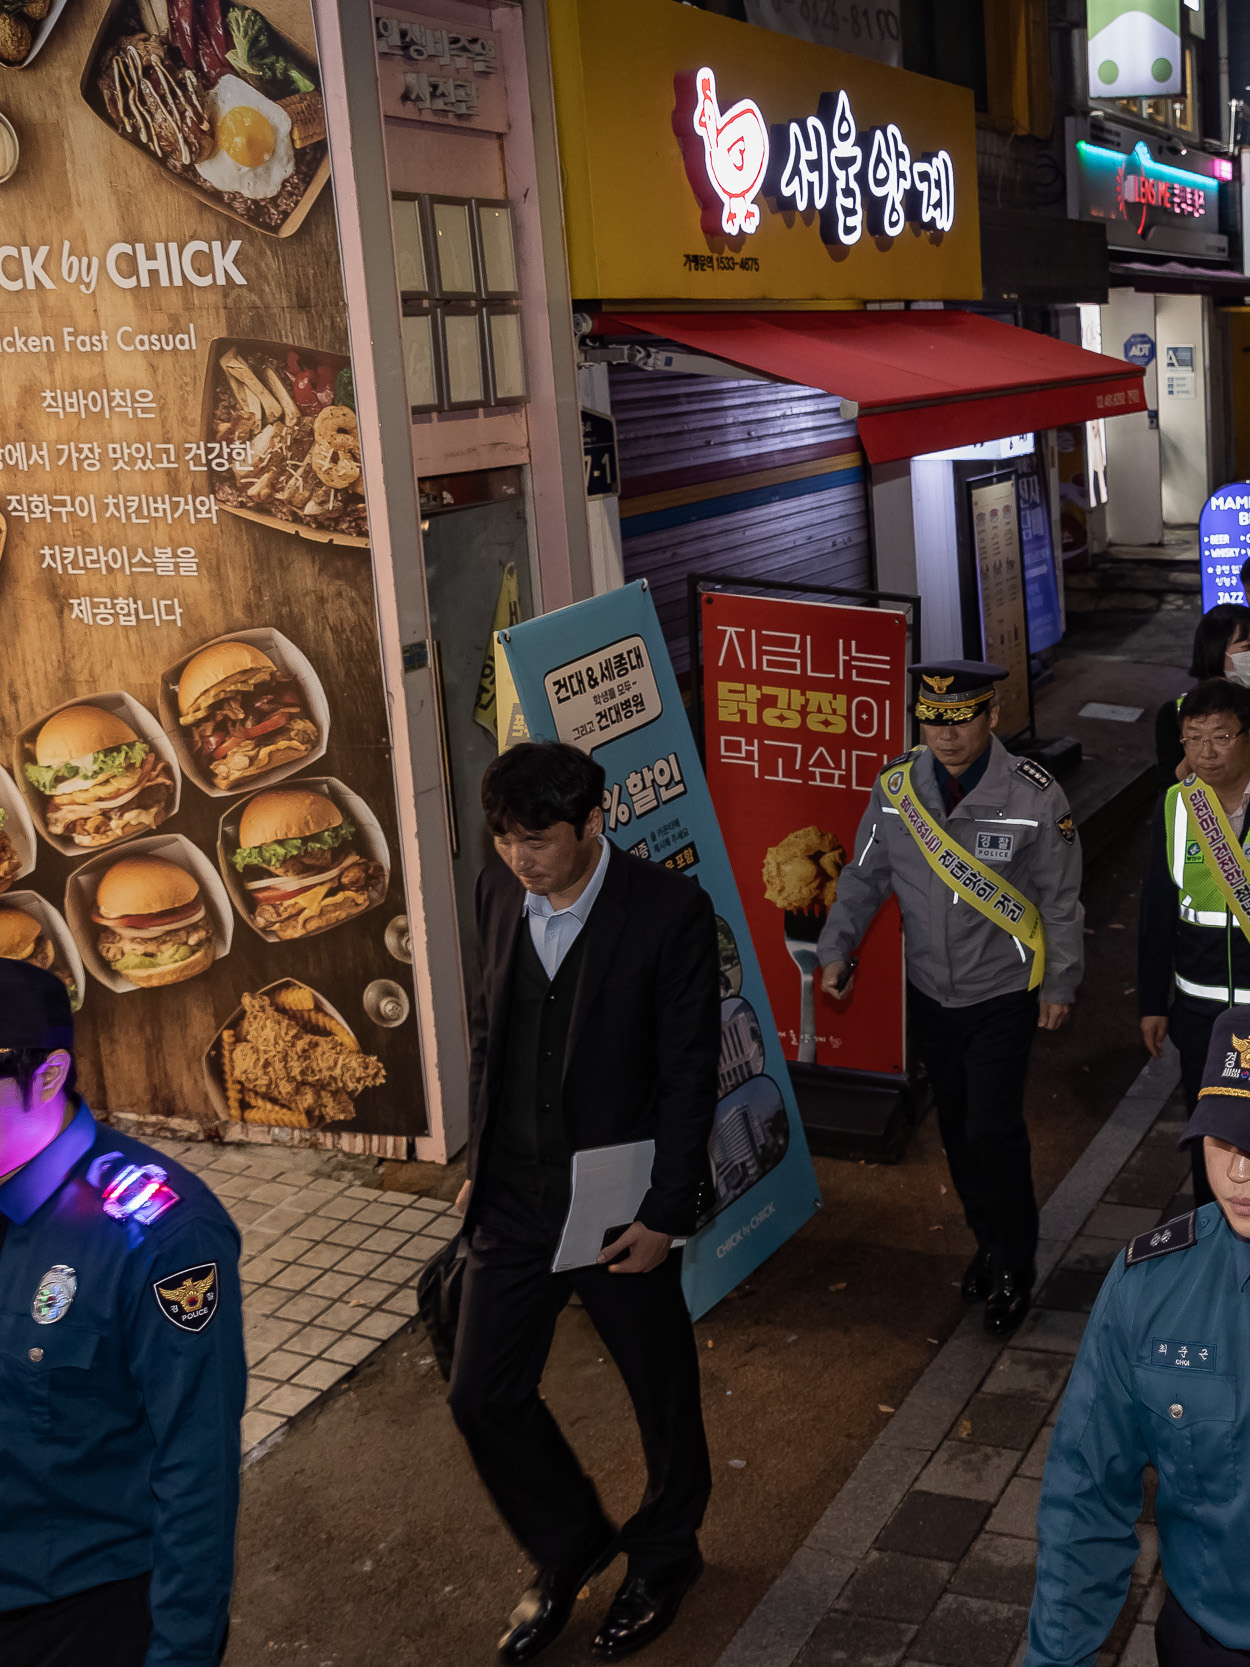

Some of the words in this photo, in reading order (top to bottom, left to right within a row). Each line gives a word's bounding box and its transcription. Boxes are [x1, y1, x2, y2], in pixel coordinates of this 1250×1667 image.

[403, 73, 480, 115] 사진관
[61, 240, 99, 295] by
[105, 240, 248, 289] CHICK
[62, 327, 109, 352] Fast
[116, 323, 197, 351] Casual
[1129, 344, 1152, 357] ADT
[41, 388, 157, 419] 칙바이칙은
[56, 441, 102, 471] 가장
[107, 441, 179, 472] 맛있고
[184, 441, 255, 472] 건강한
[6, 494, 98, 524] 직화구이
[103, 494, 219, 525] 치킨버거와
[40, 545, 199, 576] 치킨라이스볼을
[69, 596, 184, 627] 제공합니다
[1216, 592, 1244, 605] JAZZ
[572, 720, 596, 741] 그리고
[595, 692, 646, 732] 건대병원
[716, 681, 891, 741] 닭강정이
[625, 752, 688, 820] 할인
[900, 795, 943, 854] 범죄없는
[1189, 788, 1227, 847] 안전하고
[978, 849, 1010, 859] POLICE
[1212, 841, 1247, 889] 건전한
[938, 848, 998, 903] 건대맛의
[993, 892, 1026, 924] 거리
[182, 1307, 209, 1321] POLICE
[1175, 1359, 1190, 1367] CHOI
